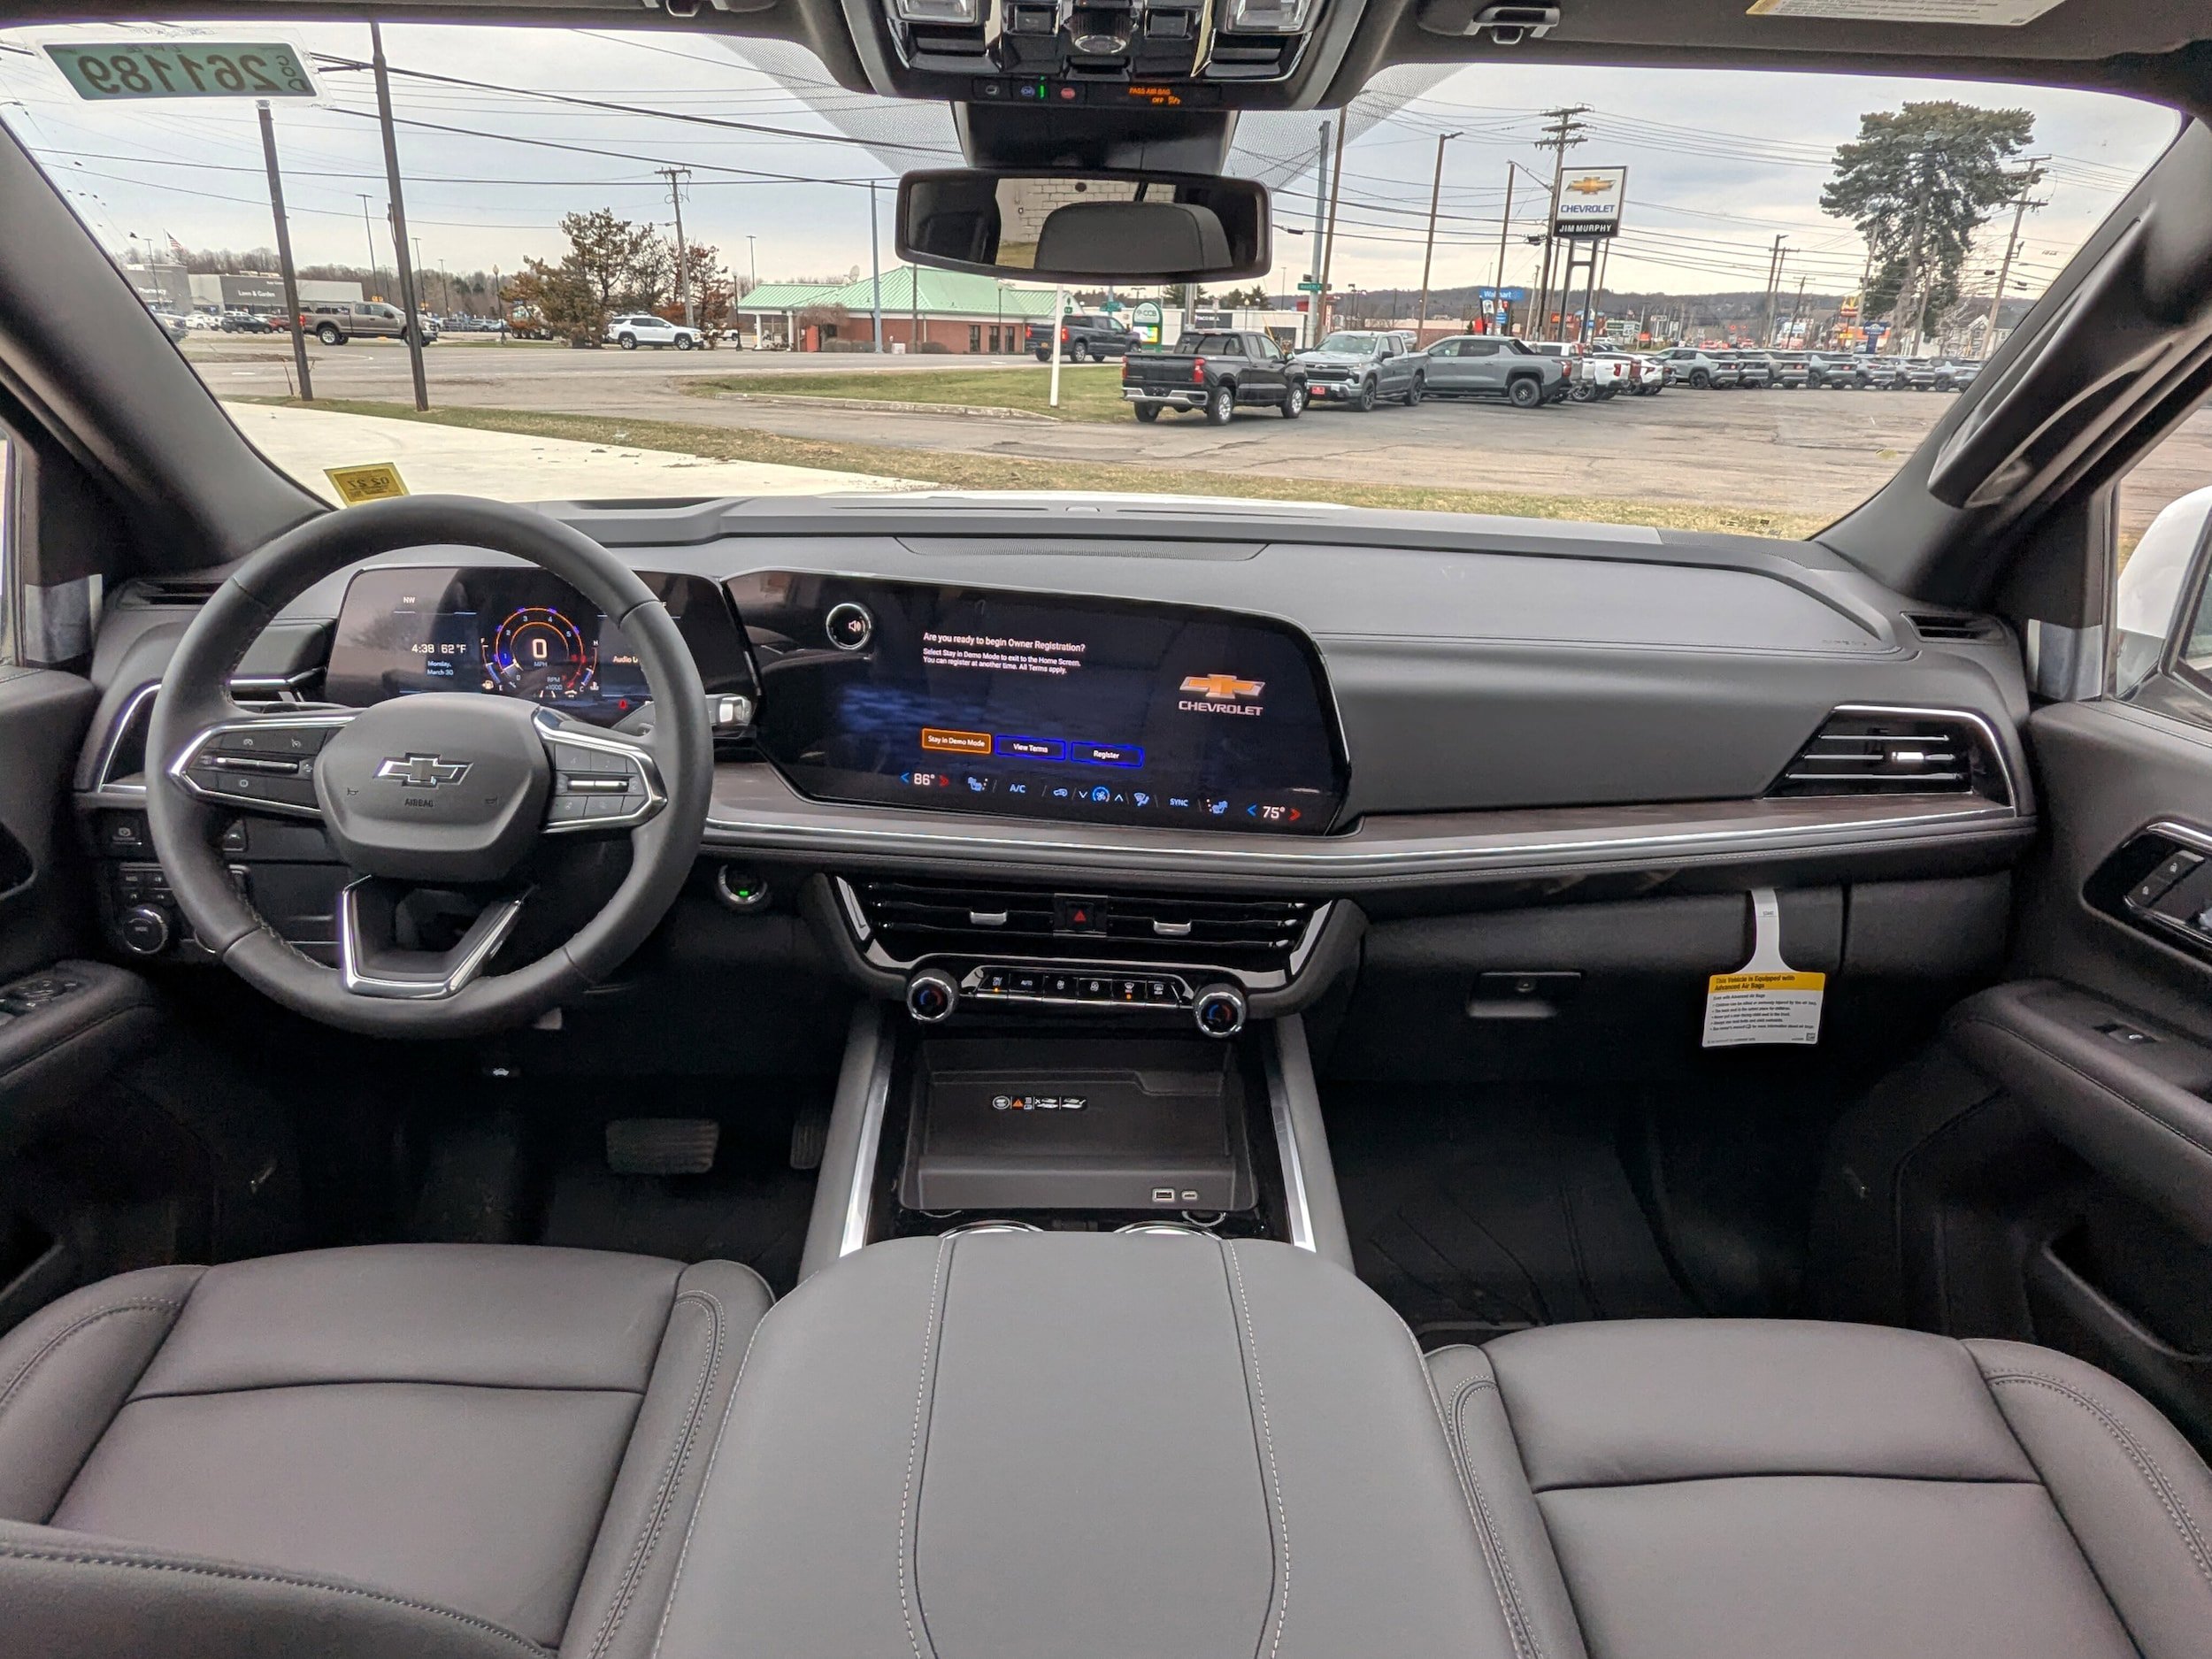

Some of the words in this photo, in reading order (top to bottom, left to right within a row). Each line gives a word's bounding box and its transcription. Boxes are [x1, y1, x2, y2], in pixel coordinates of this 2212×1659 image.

[1561, 204, 1616, 213] CHEVROLET
[1559, 224, 1575, 233] JIM
[1576, 224, 1611, 232] MURPHY
[923, 632, 937, 641] Are
[953, 635, 974, 645] ready
[985, 636, 1007, 647] begin
[1008, 638, 1033, 648] Owner
[1035, 640, 1086, 652] Registration?
[411, 644, 435, 653] 4:38
[441, 644, 455, 653] 62
[532, 639, 547, 658] 0
[942, 649, 956, 658] Stay
[1179, 701, 1263, 716] CHEVROLET
[928, 735, 941, 744] Stay
[1029, 745, 1048, 753] Terms
[1093, 750, 1119, 759] Register
[914, 773, 935, 785] 86°
[1009, 784, 1026, 793] A/C
[405, 798, 433, 807] AIRBAG
[1170, 798, 1188, 807] SYNC
[1263, 806, 1286, 818] 75°
